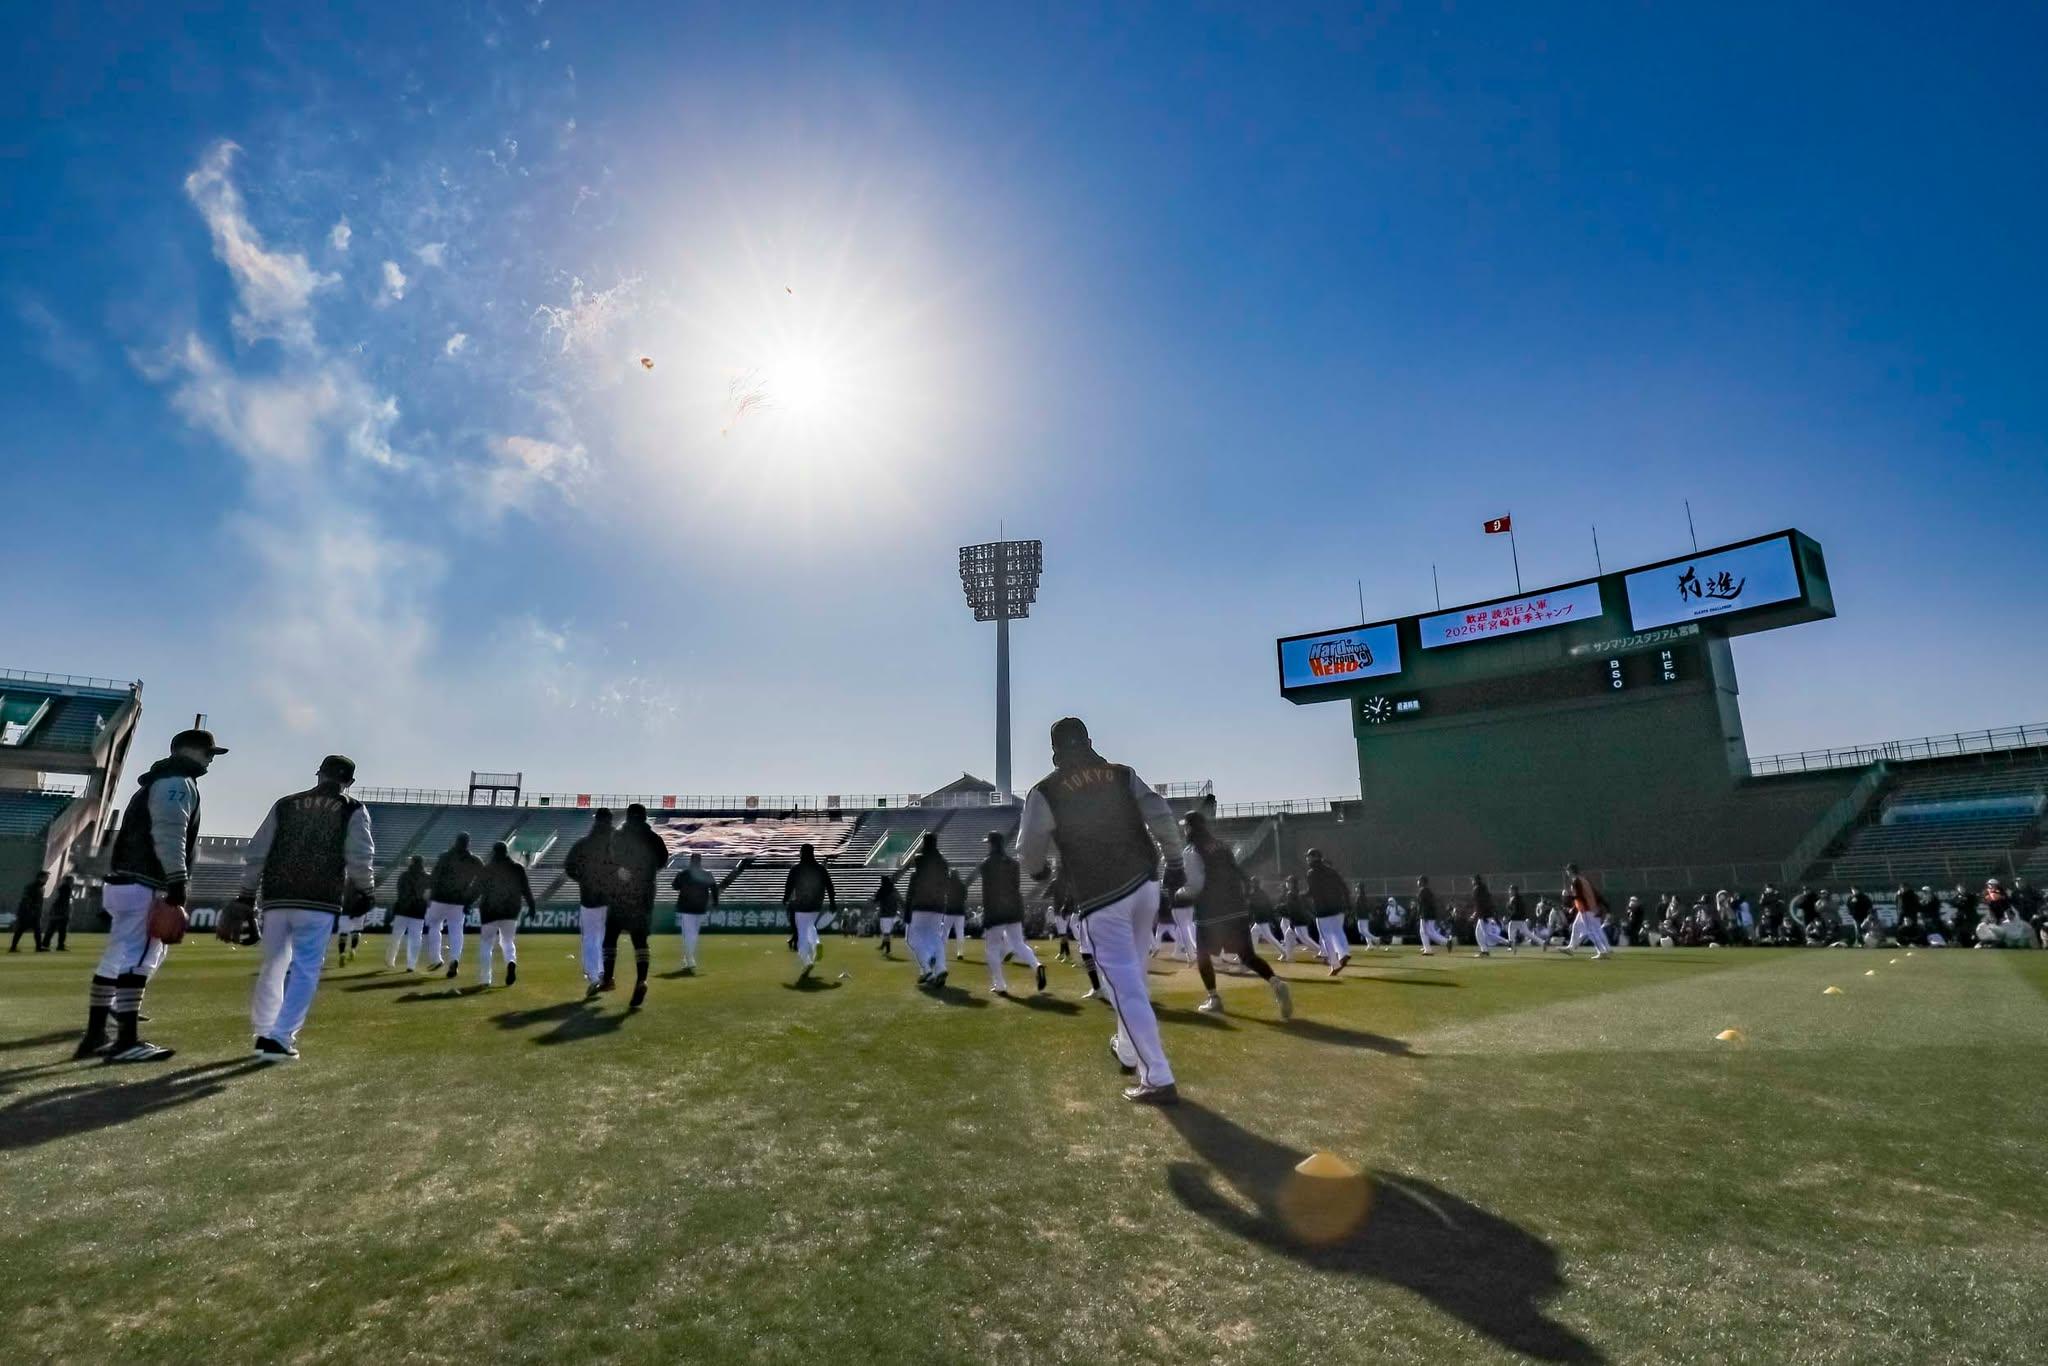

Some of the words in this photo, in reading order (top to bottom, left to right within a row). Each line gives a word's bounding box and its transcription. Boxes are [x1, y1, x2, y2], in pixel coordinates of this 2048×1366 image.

[1466, 611, 1488, 625] 歓迎
[1491, 599, 1548, 620] 読売巨人軍
[1445, 604, 1575, 638] 2026年宮崎春季キャンプ
[1661, 650, 1671, 660] H
[1309, 657, 1359, 677] HERO
[1610, 660, 1619, 669] B
[1663, 660, 1673, 670] E
[1612, 670, 1621, 678] S
[1062, 767, 1115, 792] TOKYO
